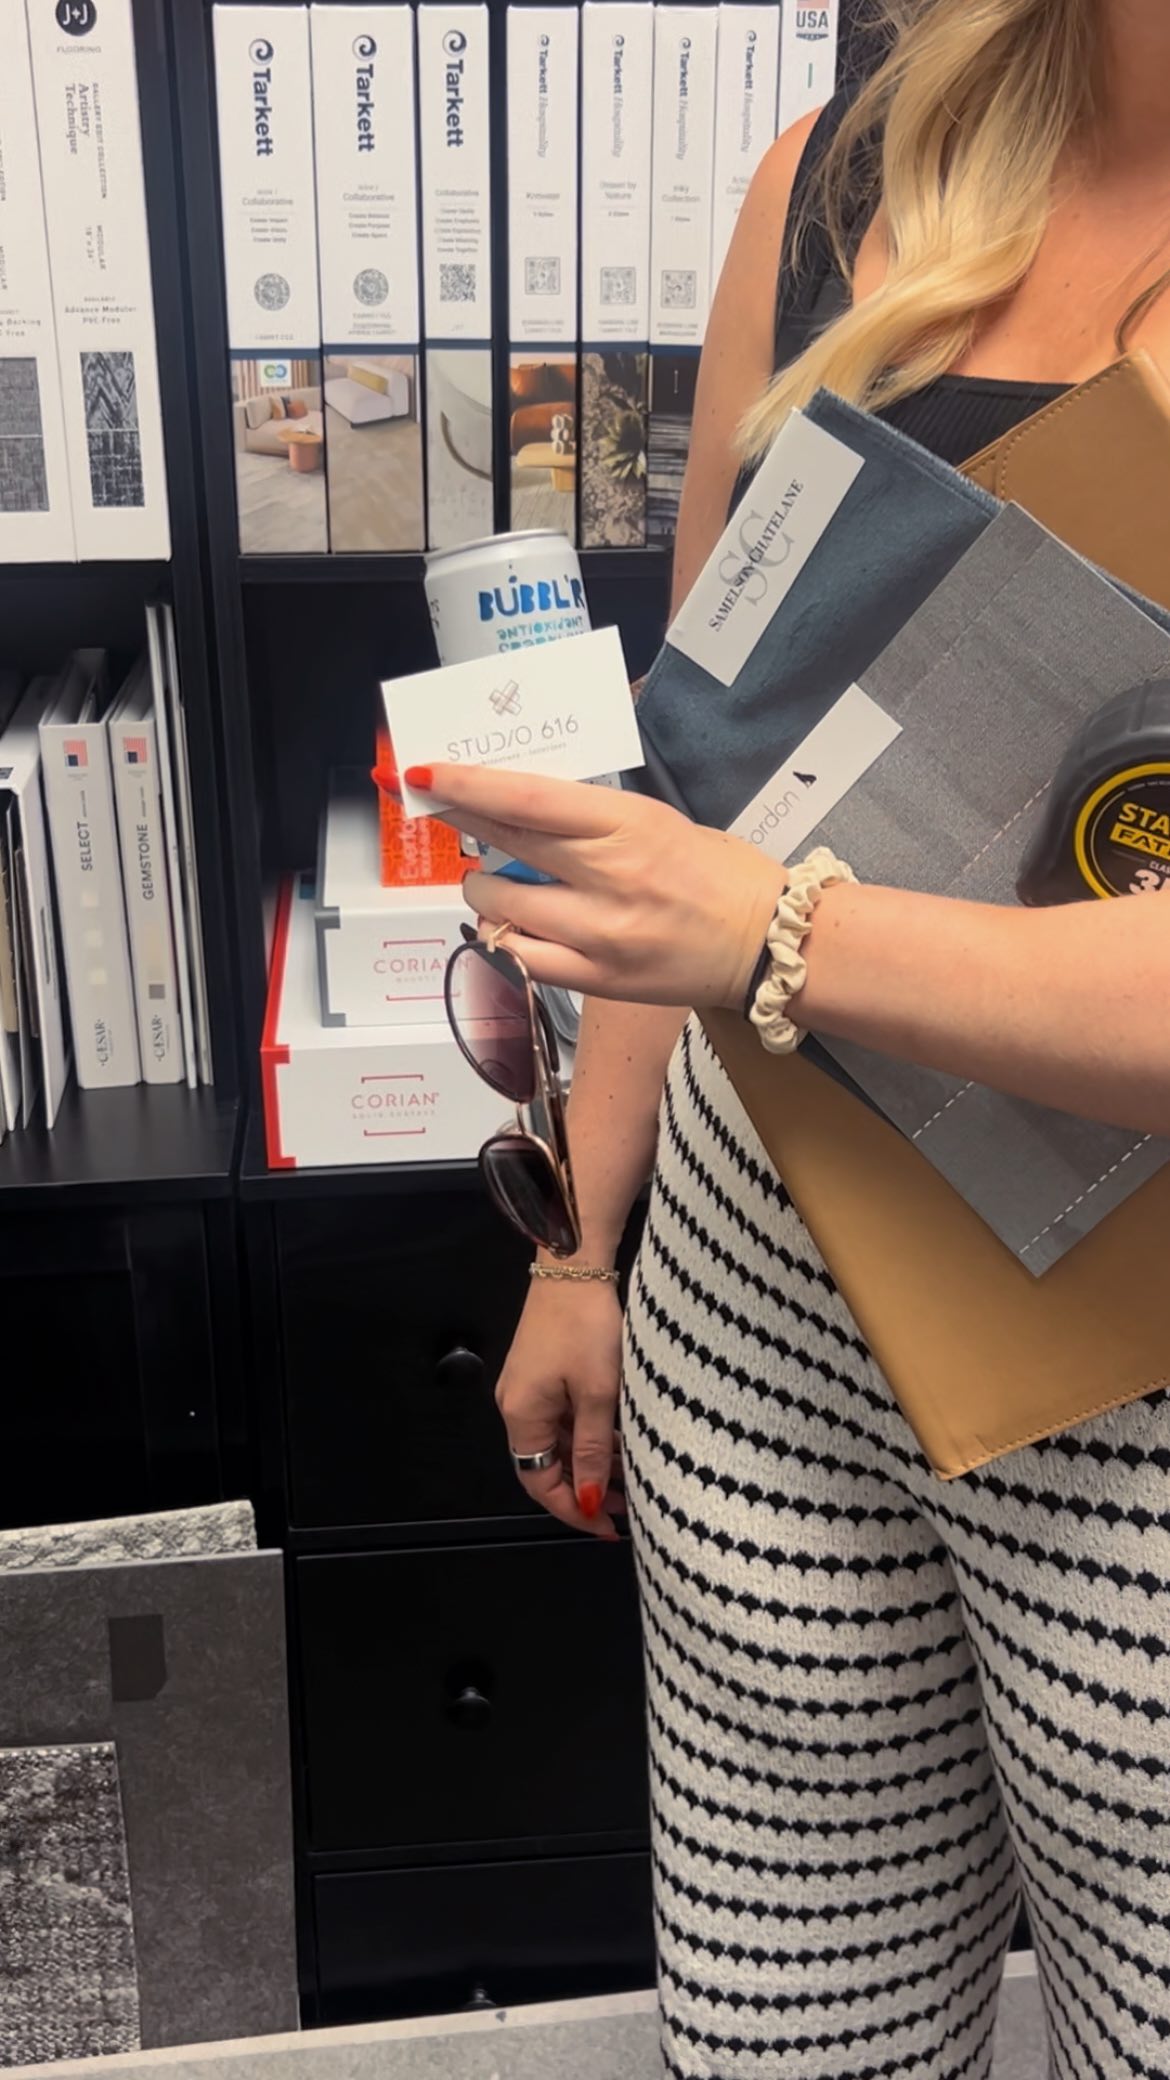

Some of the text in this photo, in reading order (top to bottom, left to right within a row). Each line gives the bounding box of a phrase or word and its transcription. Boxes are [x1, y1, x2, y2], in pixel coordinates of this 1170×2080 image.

[796, 10, 828, 28] USA
[538, 49, 548, 94] Tarkett
[613, 49, 623, 94] Tarkett
[679, 52, 690, 97] Tarkett
[745, 44, 755, 90] Tarkett
[65, 84, 78, 155] Technique
[78, 83, 91, 137] Artistry
[253, 67, 273, 157] Tarkett
[356, 64, 375, 152] Tarkett
[446, 59, 464, 148] Tarkett
[708, 478, 804, 633] SAMELSON CHATELANE
[541, 714, 579, 740] 616
[739, 790, 800, 846] ordon
[1118, 828, 1170, 856] FAT
[1119, 802, 1170, 836] STA
[77, 821, 93, 873] SELECT
[137, 822, 155, 900] GEMSTONE
